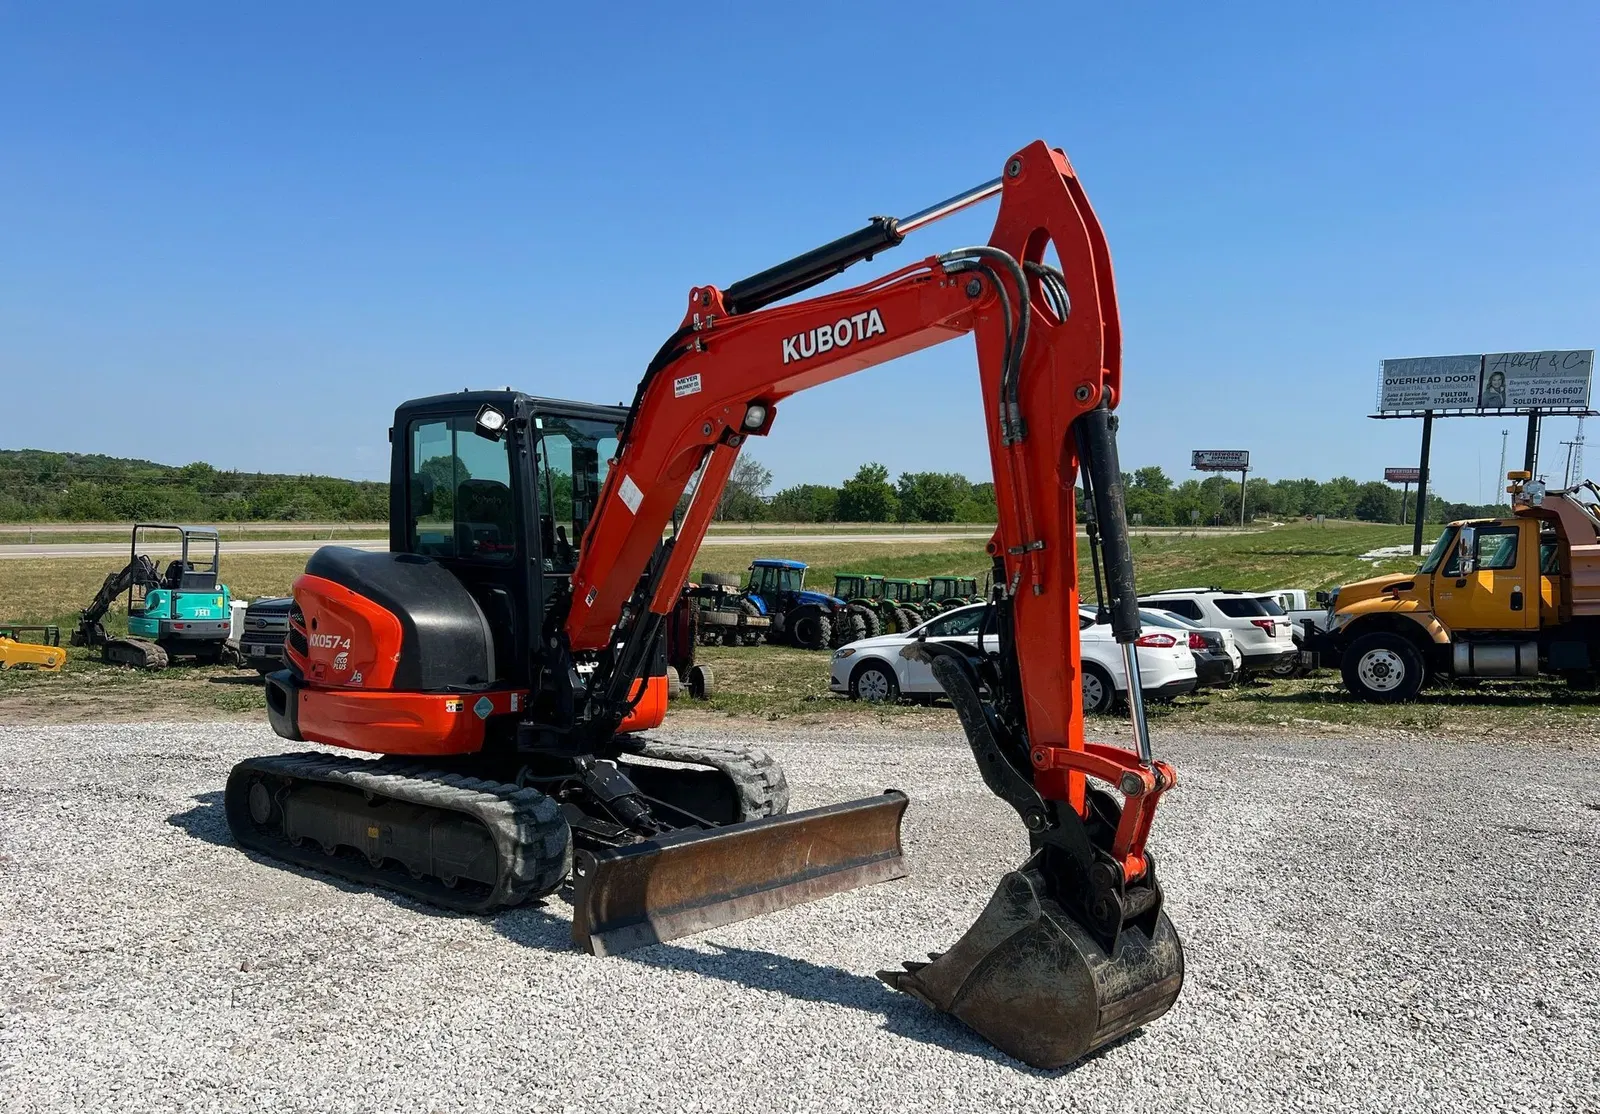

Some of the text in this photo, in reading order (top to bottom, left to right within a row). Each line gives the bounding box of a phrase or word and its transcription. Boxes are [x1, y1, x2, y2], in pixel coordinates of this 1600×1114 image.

[781, 307, 886, 364] KUBOTA
[1490, 353, 1546, 372] Abbott
[1549, 354, 1560, 371] &
[677, 375, 698, 385] MEYER
[1385, 377, 1441, 385] OVERHEAD
[1530, 386, 1583, 395] 573-416-6607
[309, 633, 351, 649] KX057-4
